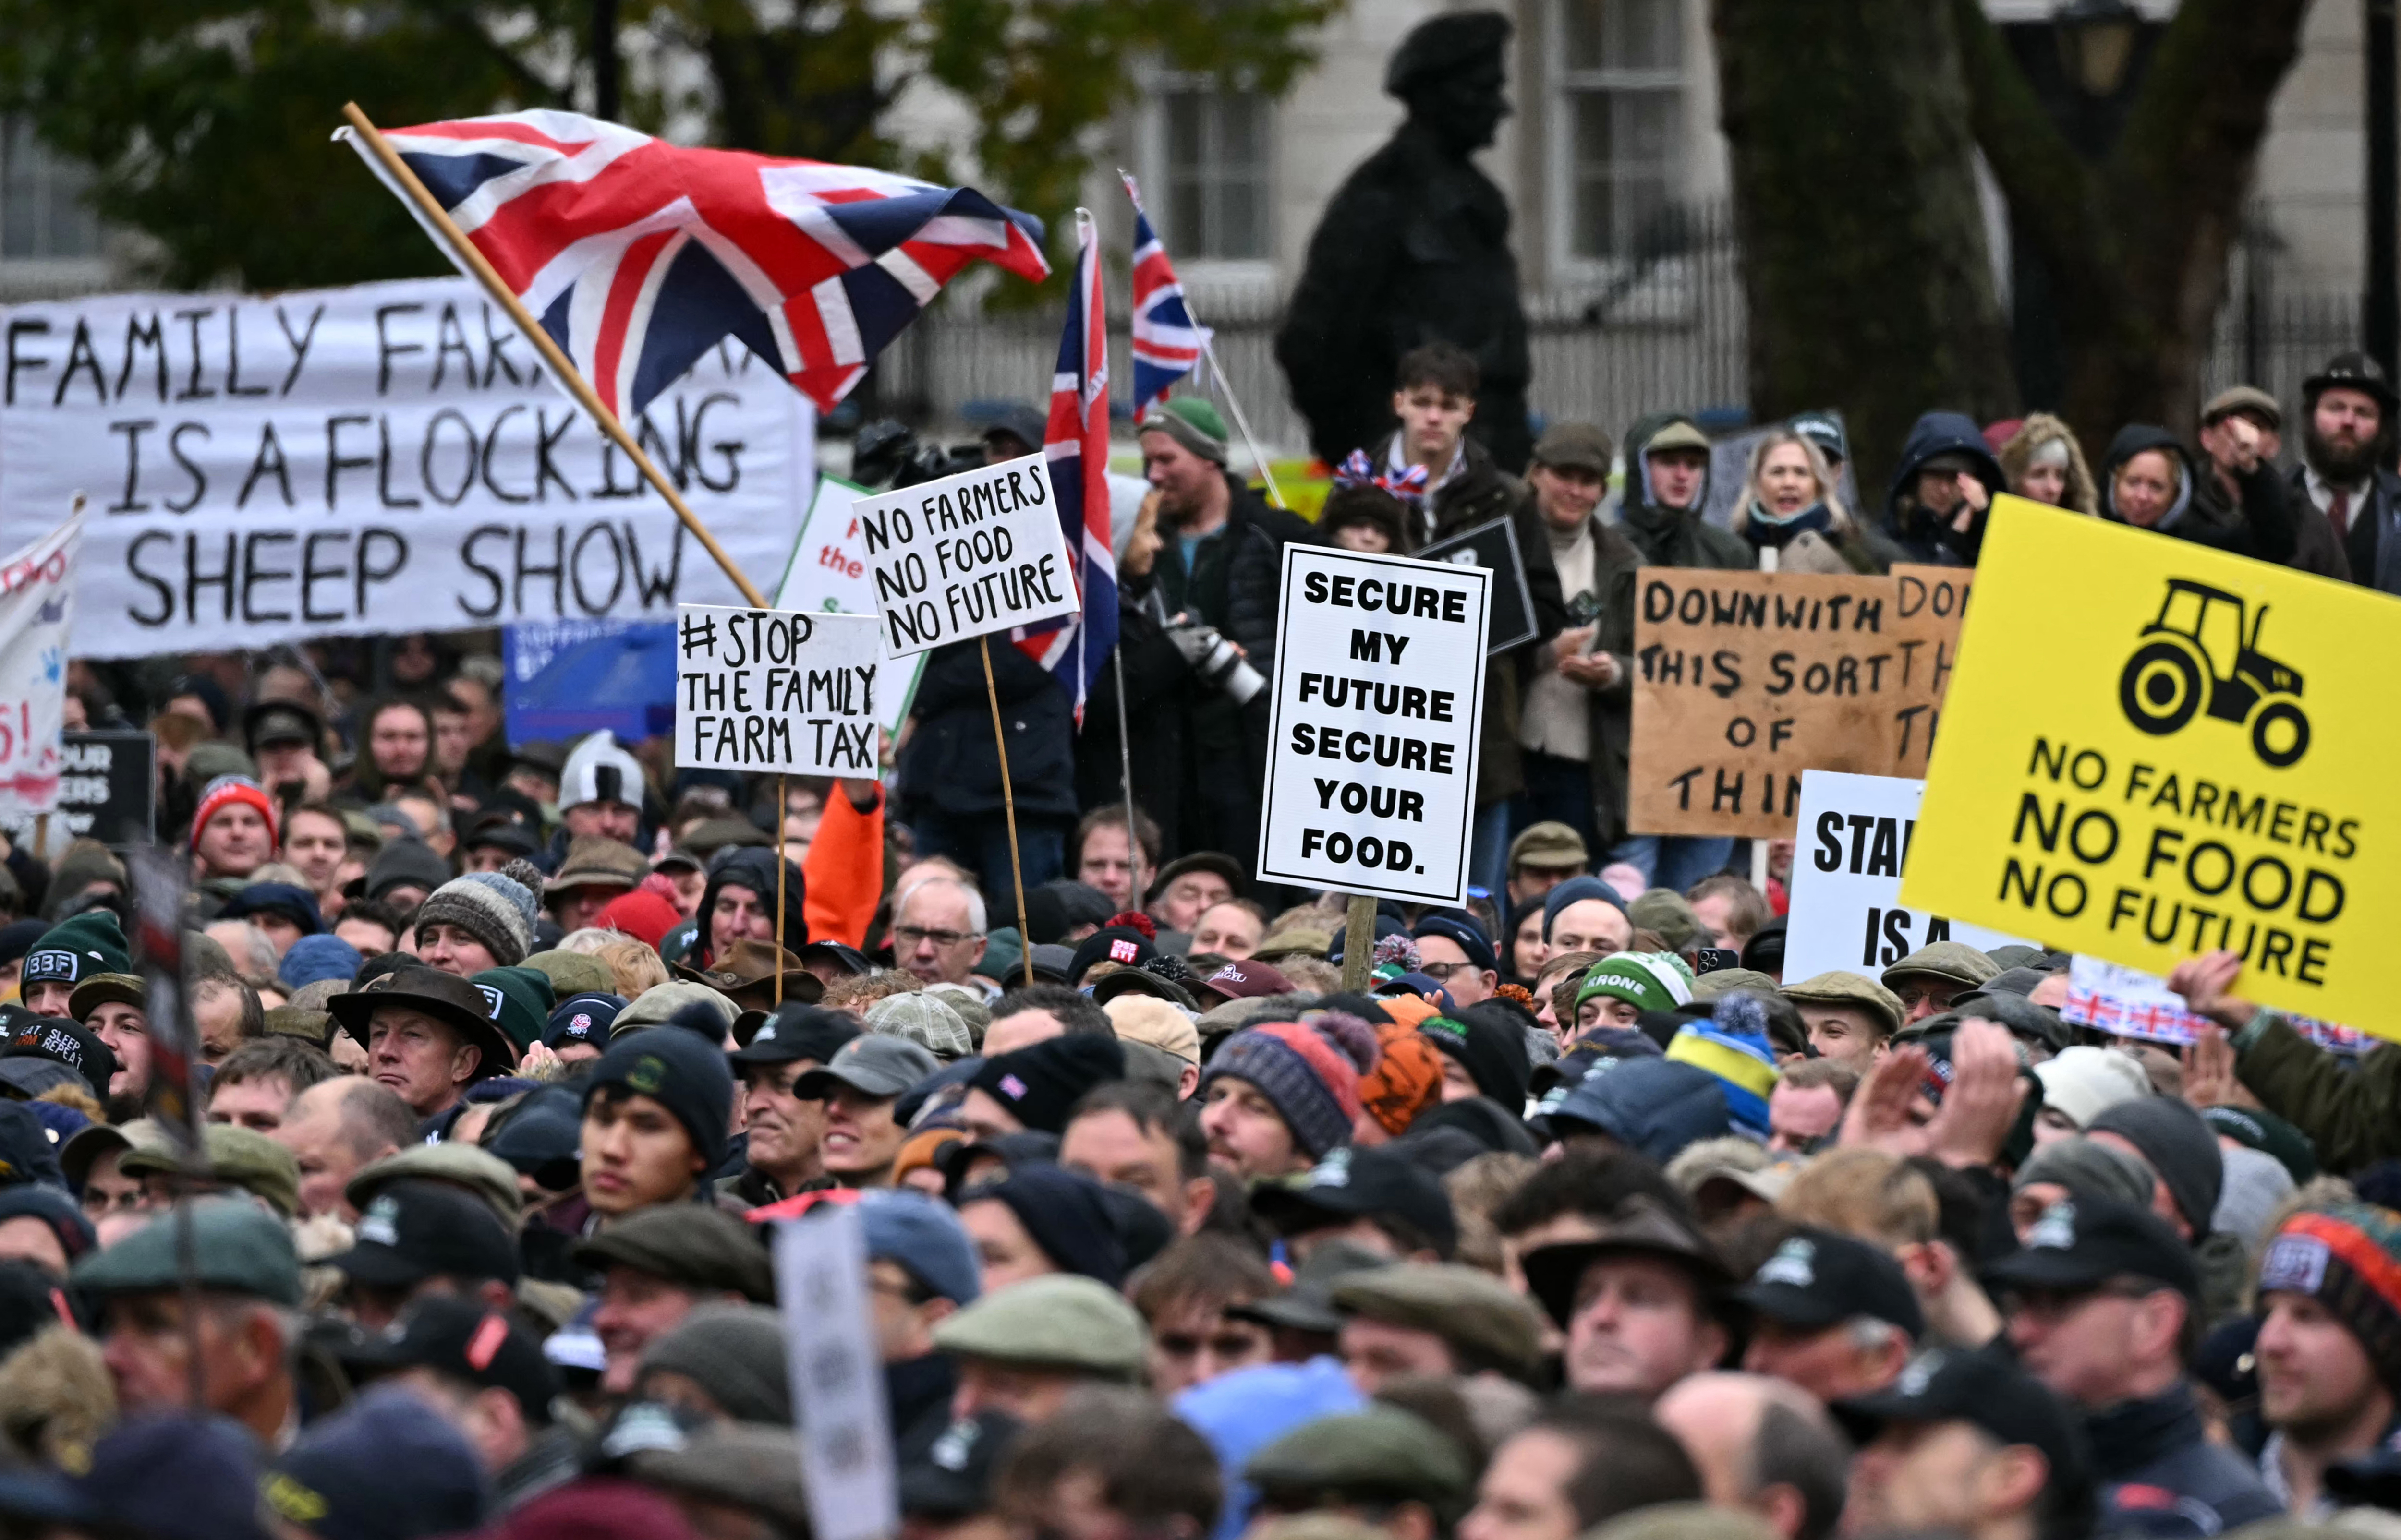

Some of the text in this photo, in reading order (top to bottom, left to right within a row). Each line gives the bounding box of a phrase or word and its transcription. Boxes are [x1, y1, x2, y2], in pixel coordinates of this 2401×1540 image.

[6, 303, 326, 407] FAMILY
[107, 391, 746, 515] IS A FLOCKING
[861, 464, 1046, 555] NO FARMERS
[126, 527, 409, 628] SHEEP
[457, 519, 686, 618] SHOW
[819, 544, 864, 579] the
[875, 525, 1013, 602] NO FOOD
[886, 553, 1063, 649] NO FUTURE
[1304, 571, 1467, 624] SECURE
[1350, 628, 1410, 665] MY
[1639, 643, 1893, 699] THIS SORT
[682, 663, 877, 716] THE FAMILY
[1298, 672, 1455, 723] FUTURE
[694, 715, 874, 769] FARM TAX
[1290, 722, 1455, 775] SECURE
[1726, 717, 1796, 752] OF
[1313, 778, 1425, 823] YOUR
[1668, 767, 1803, 818] THIN
[2027, 736, 2361, 860] NO FARMERS
[1301, 828, 1425, 875] FOOD.
[2012, 792, 2346, 924] NO FOOD
[1863, 907, 1912, 968] IS
[1998, 858, 2333, 987] NO FUTURE
[29, 954, 70, 974] BBF
[1587, 973, 1647, 997] KRONE
